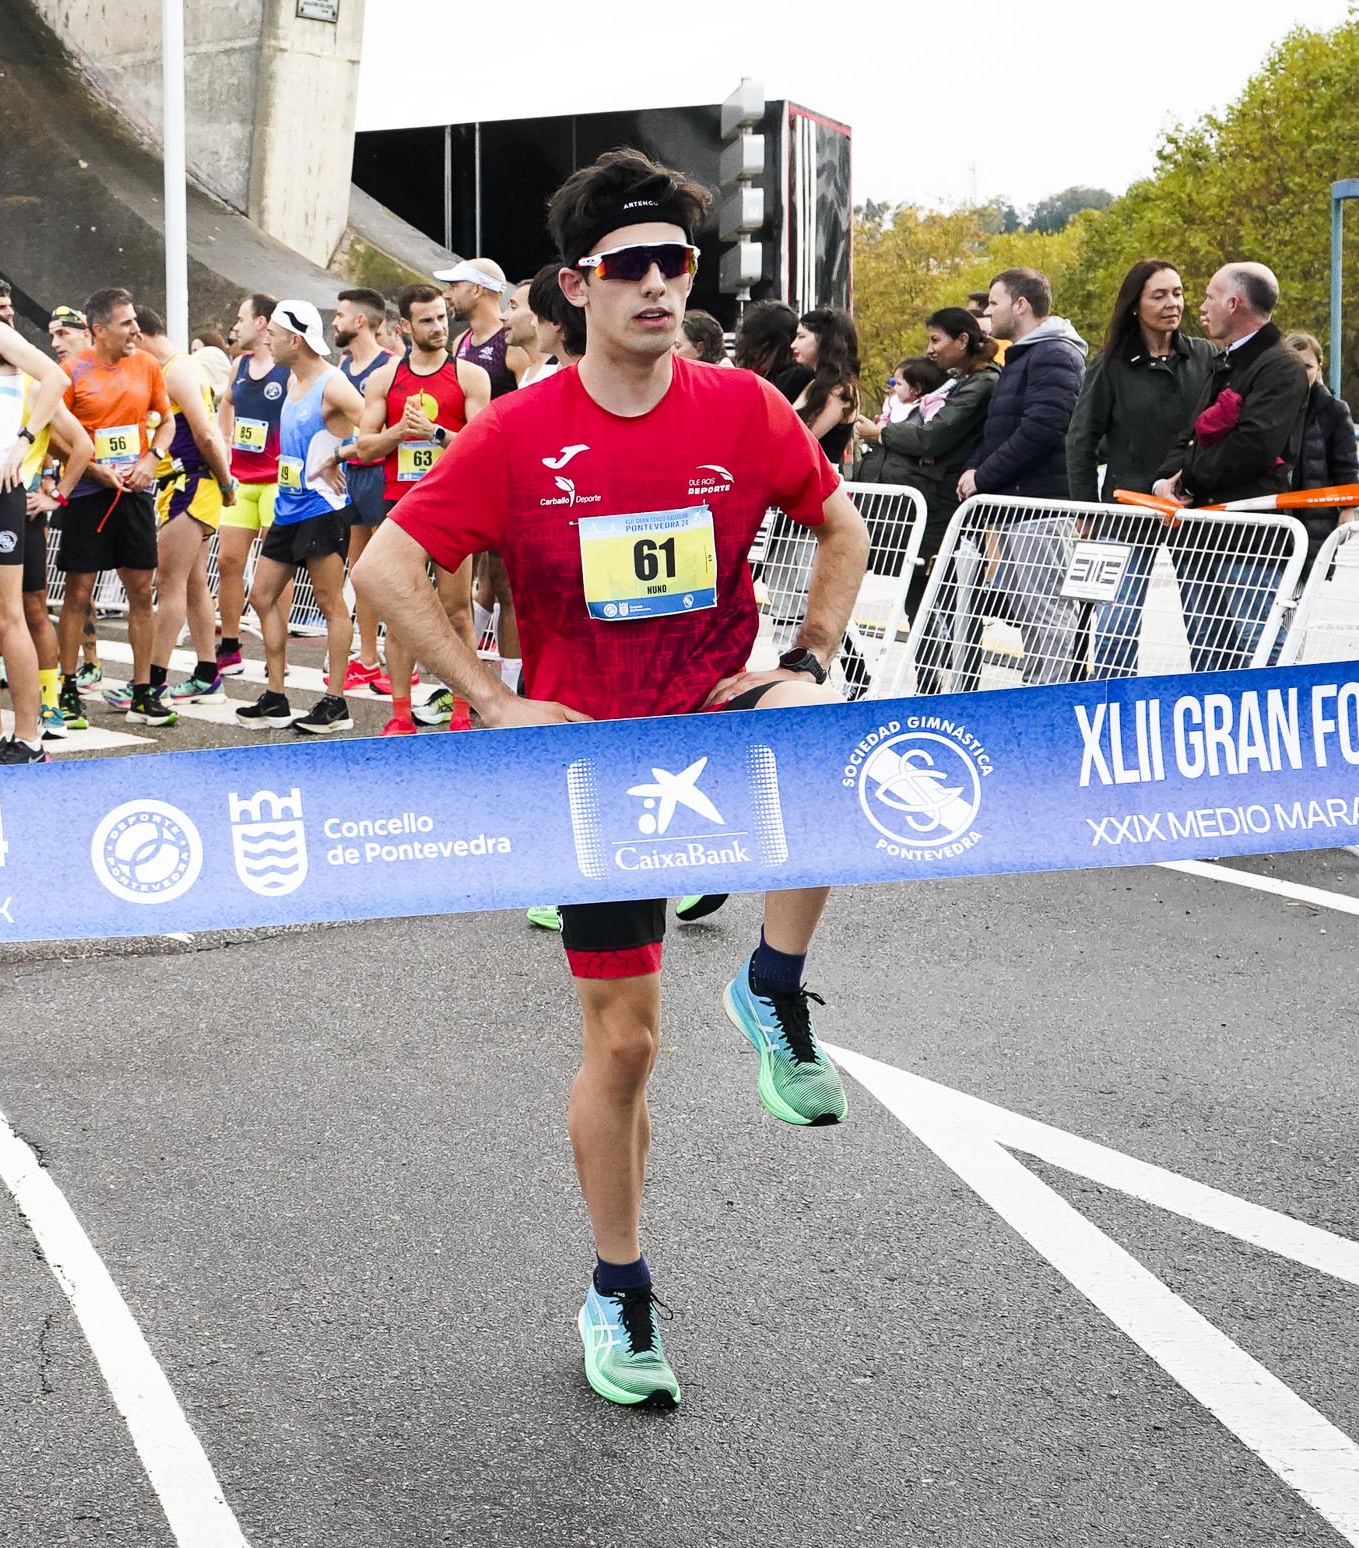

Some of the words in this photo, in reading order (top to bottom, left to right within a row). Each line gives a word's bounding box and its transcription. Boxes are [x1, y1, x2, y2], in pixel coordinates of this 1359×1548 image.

[109, 436, 127, 452] 56
[413, 450, 433, 467] 63
[540, 496, 570, 506] Carballo
[575, 494, 602, 504] Deporte
[688, 484, 731, 495] DEPORTE
[626, 520, 680, 532] PONTEVEDRA
[633, 537, 676, 581] 61
[647, 584, 667, 594] NUNO
[842, 721, 901, 787] SOCIEDAD
[906, 716, 994, 777] GIMNÁSTICA
[1074, 700, 1165, 787] XLII
[1173, 688, 1303, 779] GRAN
[324, 811, 434, 841] Concello
[1085, 813, 1171, 848] XXIX
[1168, 804, 1272, 841] MEDIO
[326, 844, 362, 866] de
[367, 835, 512, 862] Pontevedra
[614, 841, 753, 871] CaixaBank
[875, 831, 983, 861] PONTEVEDRA
